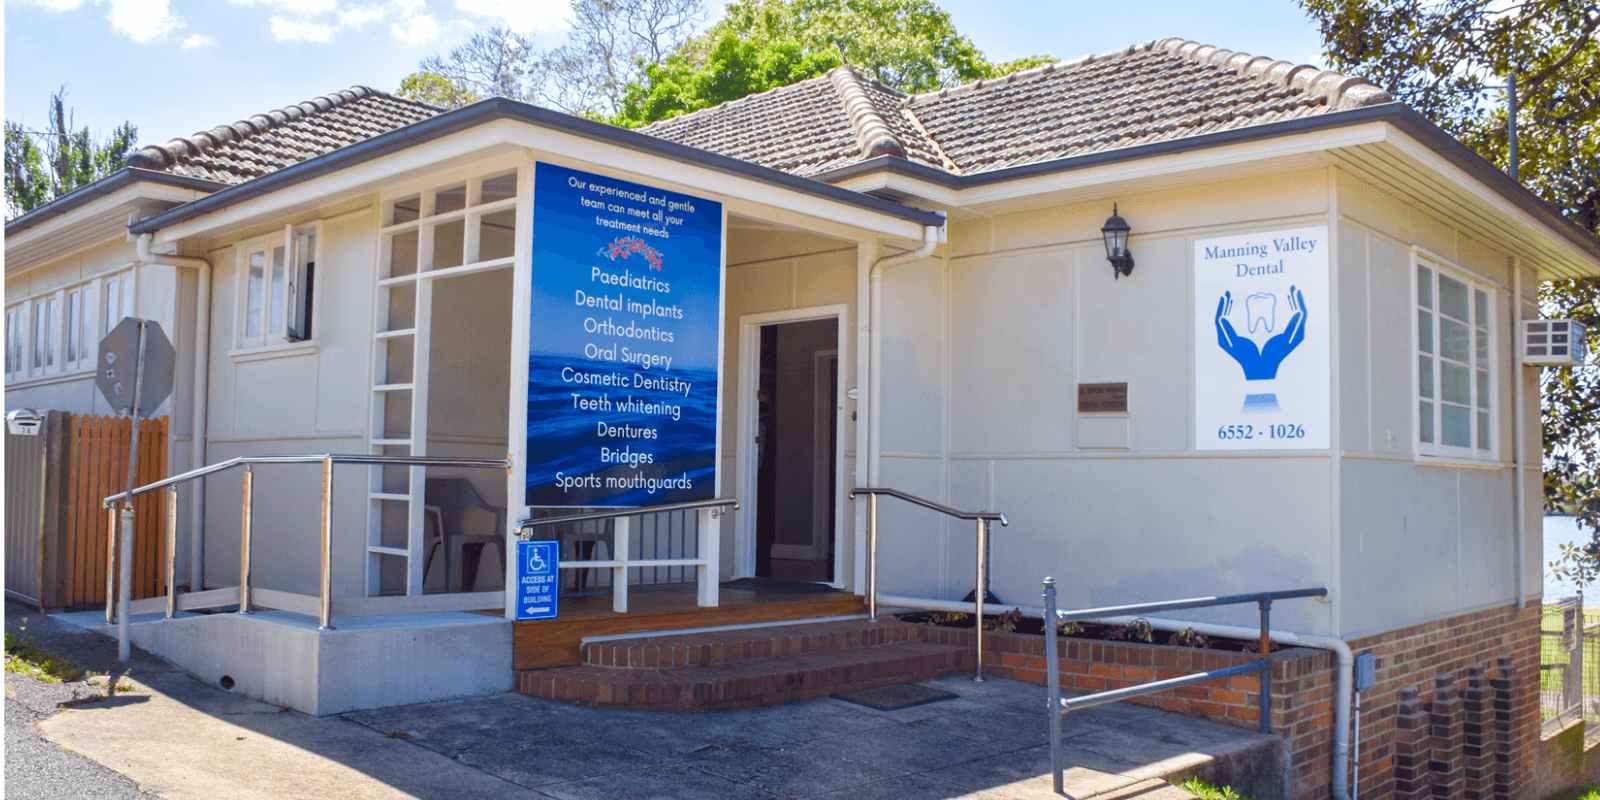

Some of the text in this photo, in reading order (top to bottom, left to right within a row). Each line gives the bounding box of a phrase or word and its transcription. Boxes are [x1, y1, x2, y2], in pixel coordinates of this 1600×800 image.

[568, 177, 695, 213] Our experienced and gentle
[581, 196, 684, 226] team can meet all your
[596, 216, 670, 238] treatment needs
[1204, 237, 1317, 260] Manning Valley
[591, 267, 670, 293] Paediatrics
[1236, 260, 1283, 277] Dental
[575, 291, 683, 320] Dental implants
[584, 318, 674, 343] Orthodontics
[584, 344, 673, 371] Oral Surgery
[561, 367, 691, 397] Cosmetic Dentistry
[571, 394, 681, 421] Teeth whitening
[597, 422, 658, 440] Dentures
[1218, 425, 1253, 439] 6552
[1269, 424, 1305, 439] 1026
[600, 448, 653, 468] Bridges
[556, 471, 692, 493] Sports mouthguards
[522, 576, 545, 584] ACCESS
[524, 595, 551, 604] BUILDING
